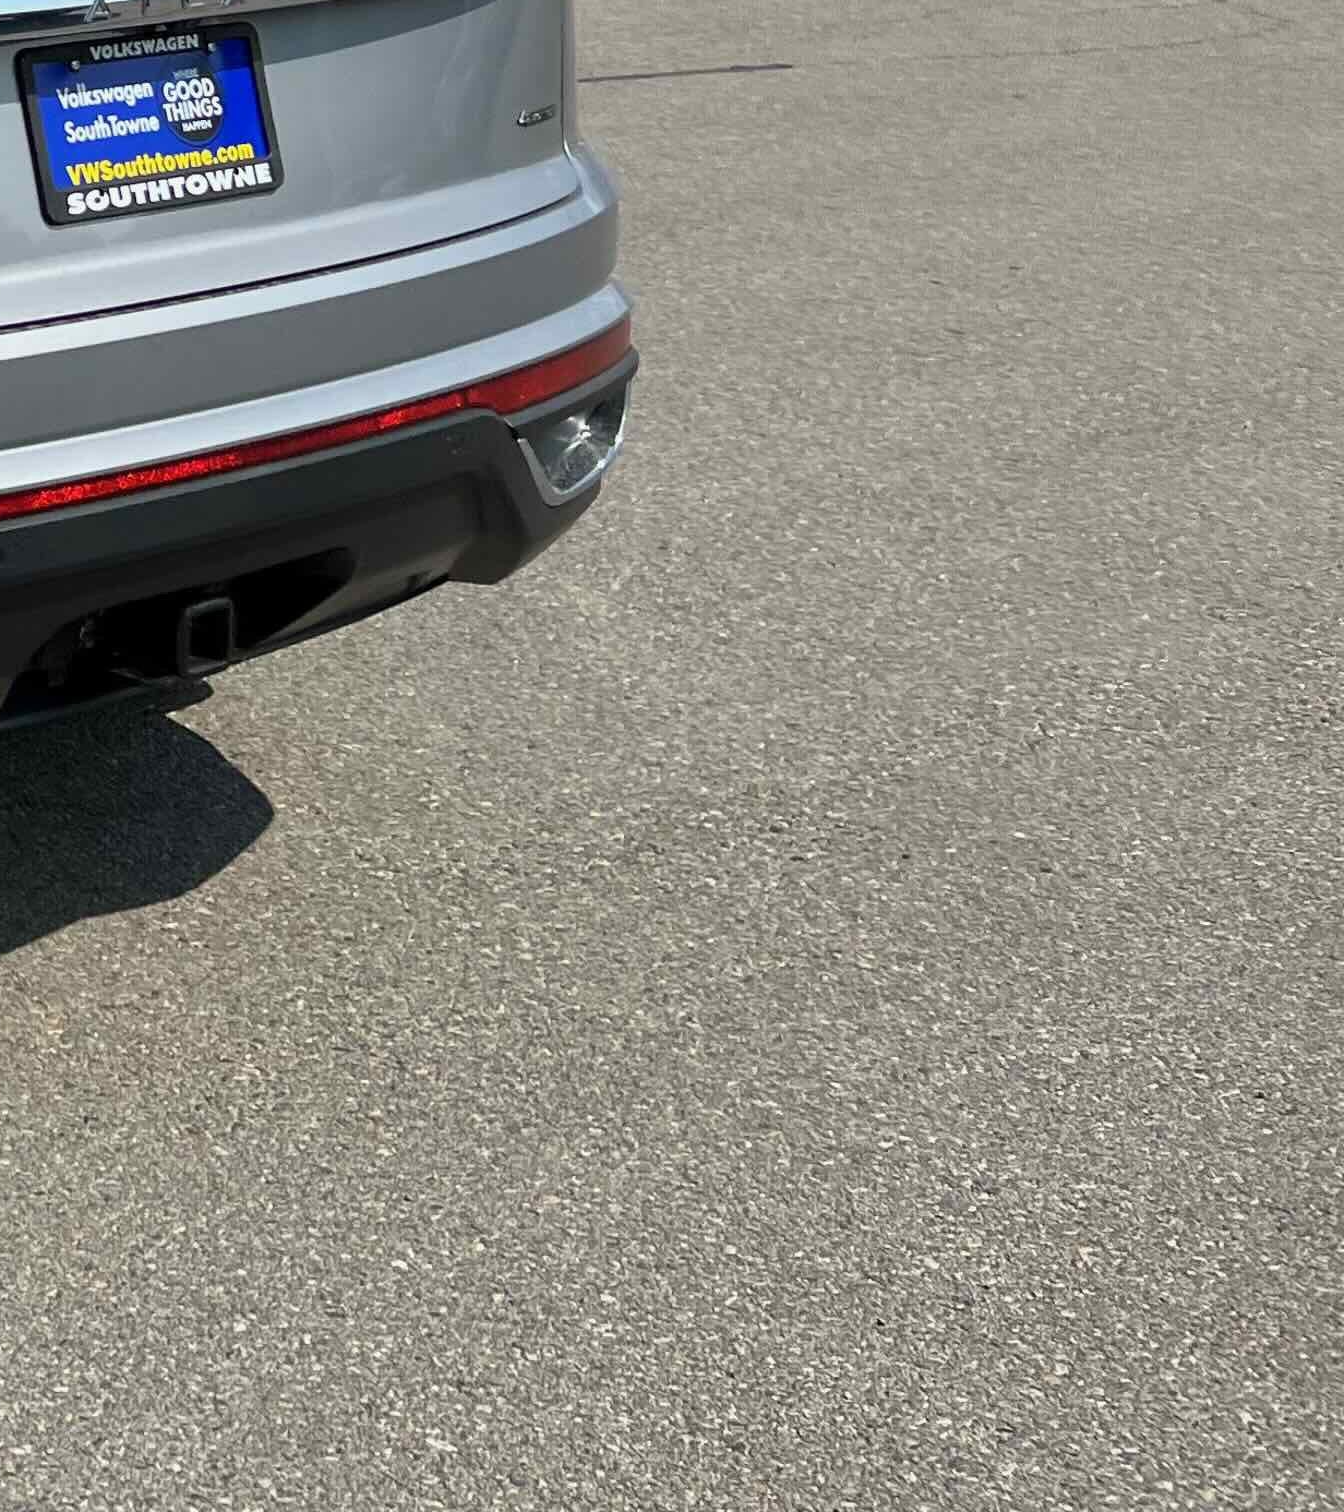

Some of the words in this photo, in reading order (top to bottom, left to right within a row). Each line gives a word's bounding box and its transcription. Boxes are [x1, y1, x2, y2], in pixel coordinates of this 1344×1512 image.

[89, 33, 200, 61] VOLKSWAGEN
[56, 81, 154, 110] Volkswagen
[162, 77, 215, 102] GOOD
[162, 96, 224, 122] THINGS
[65, 142, 255, 186] VWSouthtowne.com
[66, 161, 273, 216] SOUTHTOWNE
